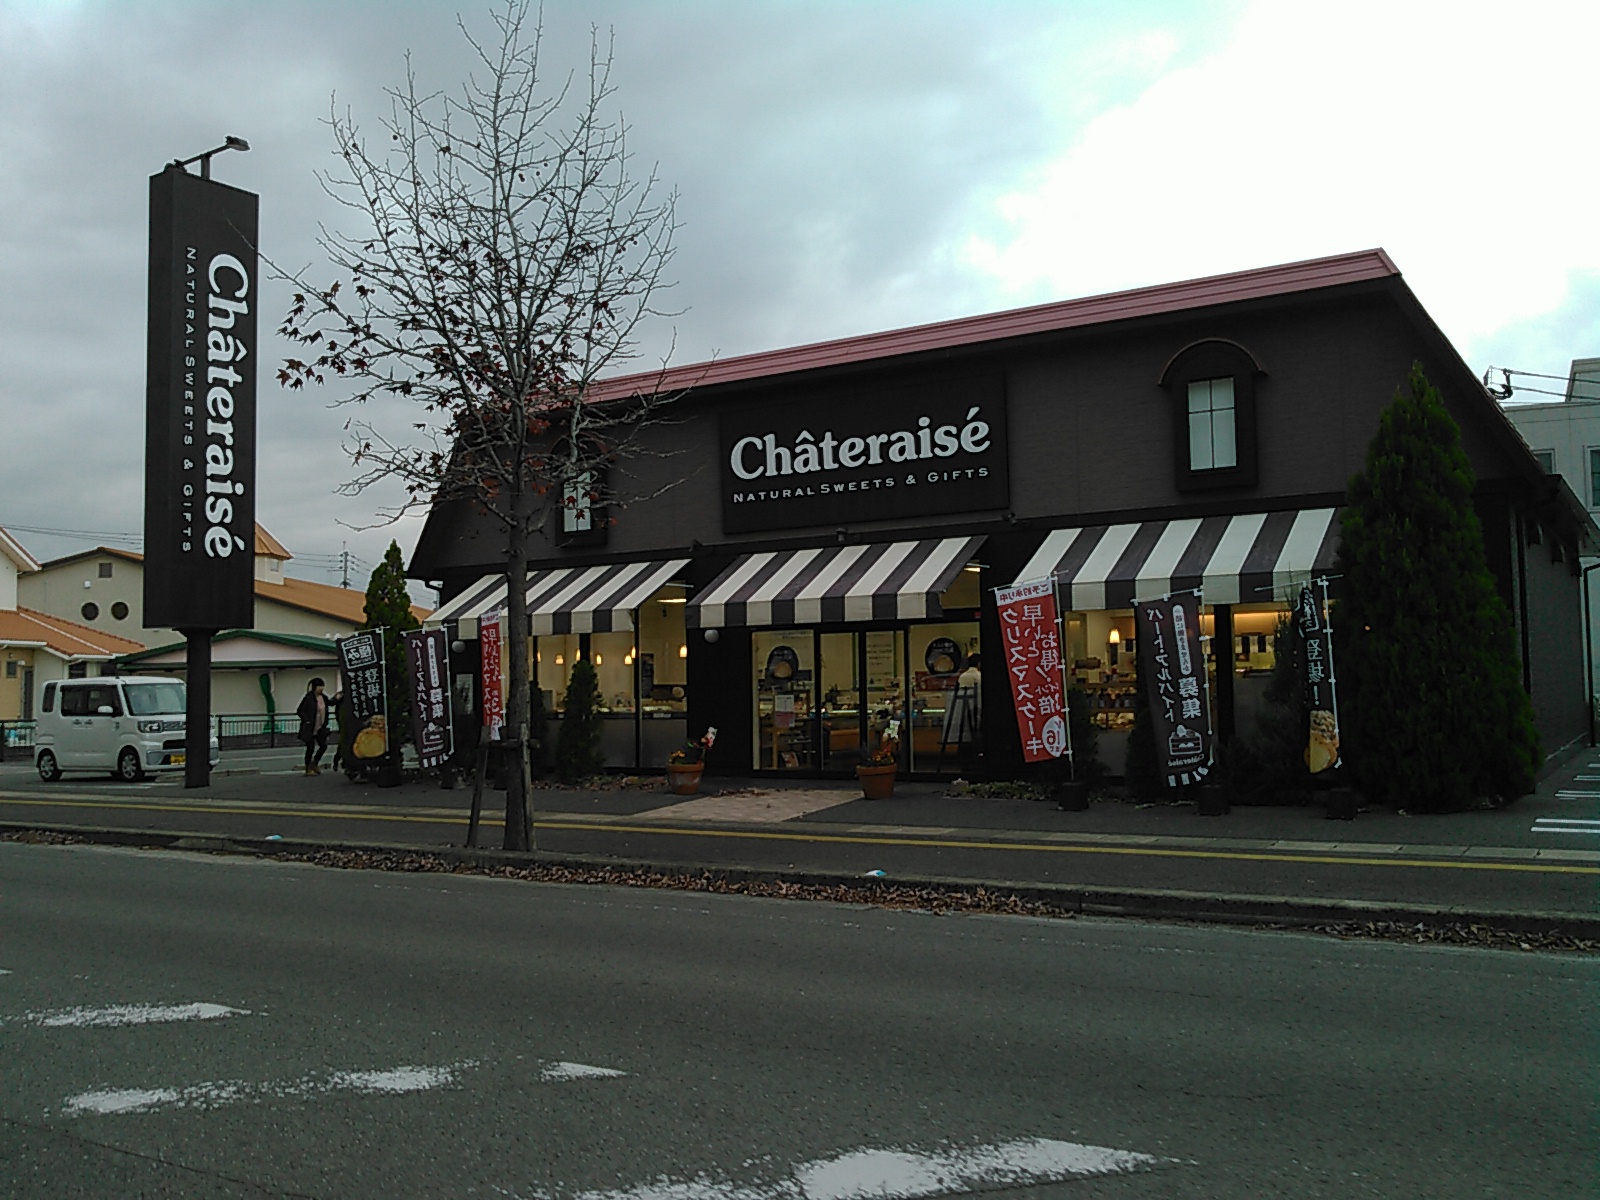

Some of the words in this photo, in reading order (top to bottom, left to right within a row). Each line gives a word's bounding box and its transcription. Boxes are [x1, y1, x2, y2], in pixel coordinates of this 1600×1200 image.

[185, 247, 197, 348] NATURAL
[184, 356, 196, 445] SWEETS
[204, 253, 249, 558] Châteraisé
[183, 458, 194, 470] &
[731, 406, 990, 480] Châteraisé
[182, 484, 194, 552] GIFTS
[733, 486, 815, 503] NATURAL
[820, 477, 895, 493] SWEETS
[905, 474, 917, 485] &
[927, 467, 989, 482] GIFTS
